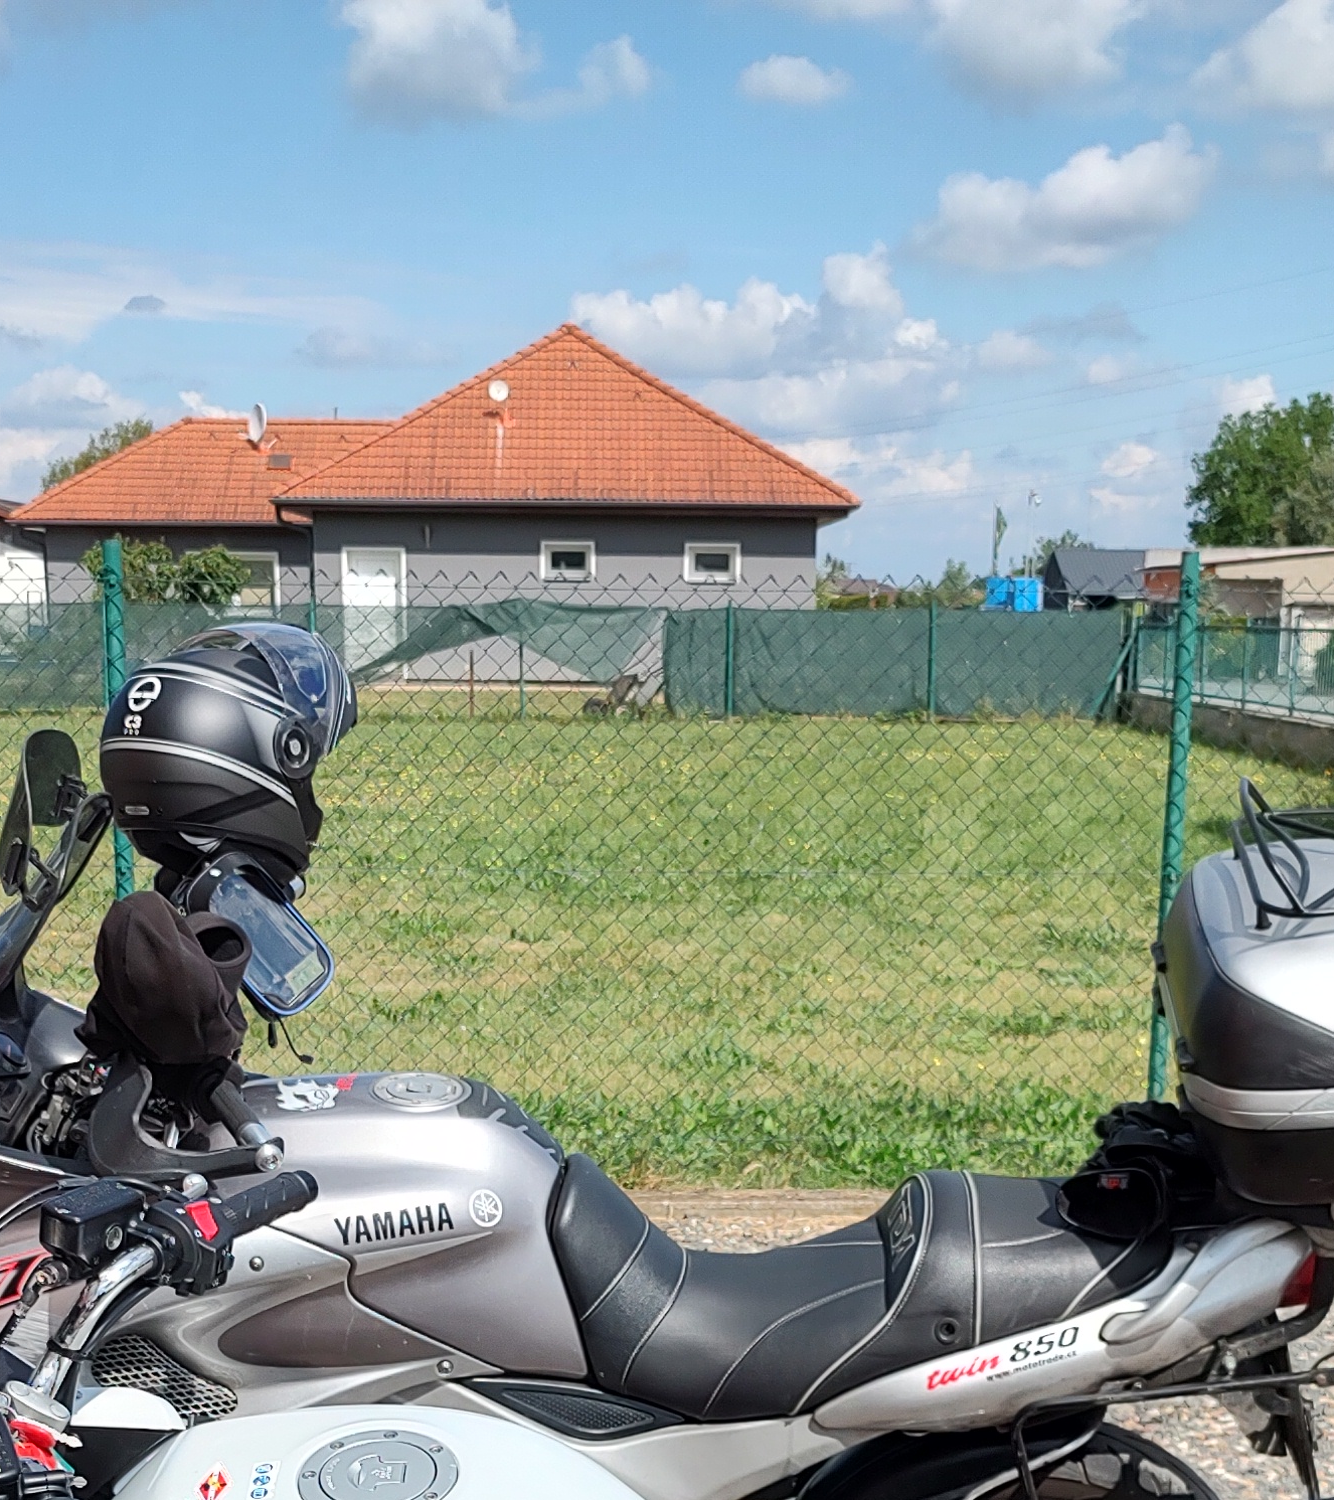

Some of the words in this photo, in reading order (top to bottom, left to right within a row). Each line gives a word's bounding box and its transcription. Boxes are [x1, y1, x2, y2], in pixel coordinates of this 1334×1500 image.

[333, 1202, 455, 1246] YAMAHA
[926, 1355, 1000, 1391] twin
[1009, 1326, 1080, 1363] 850
